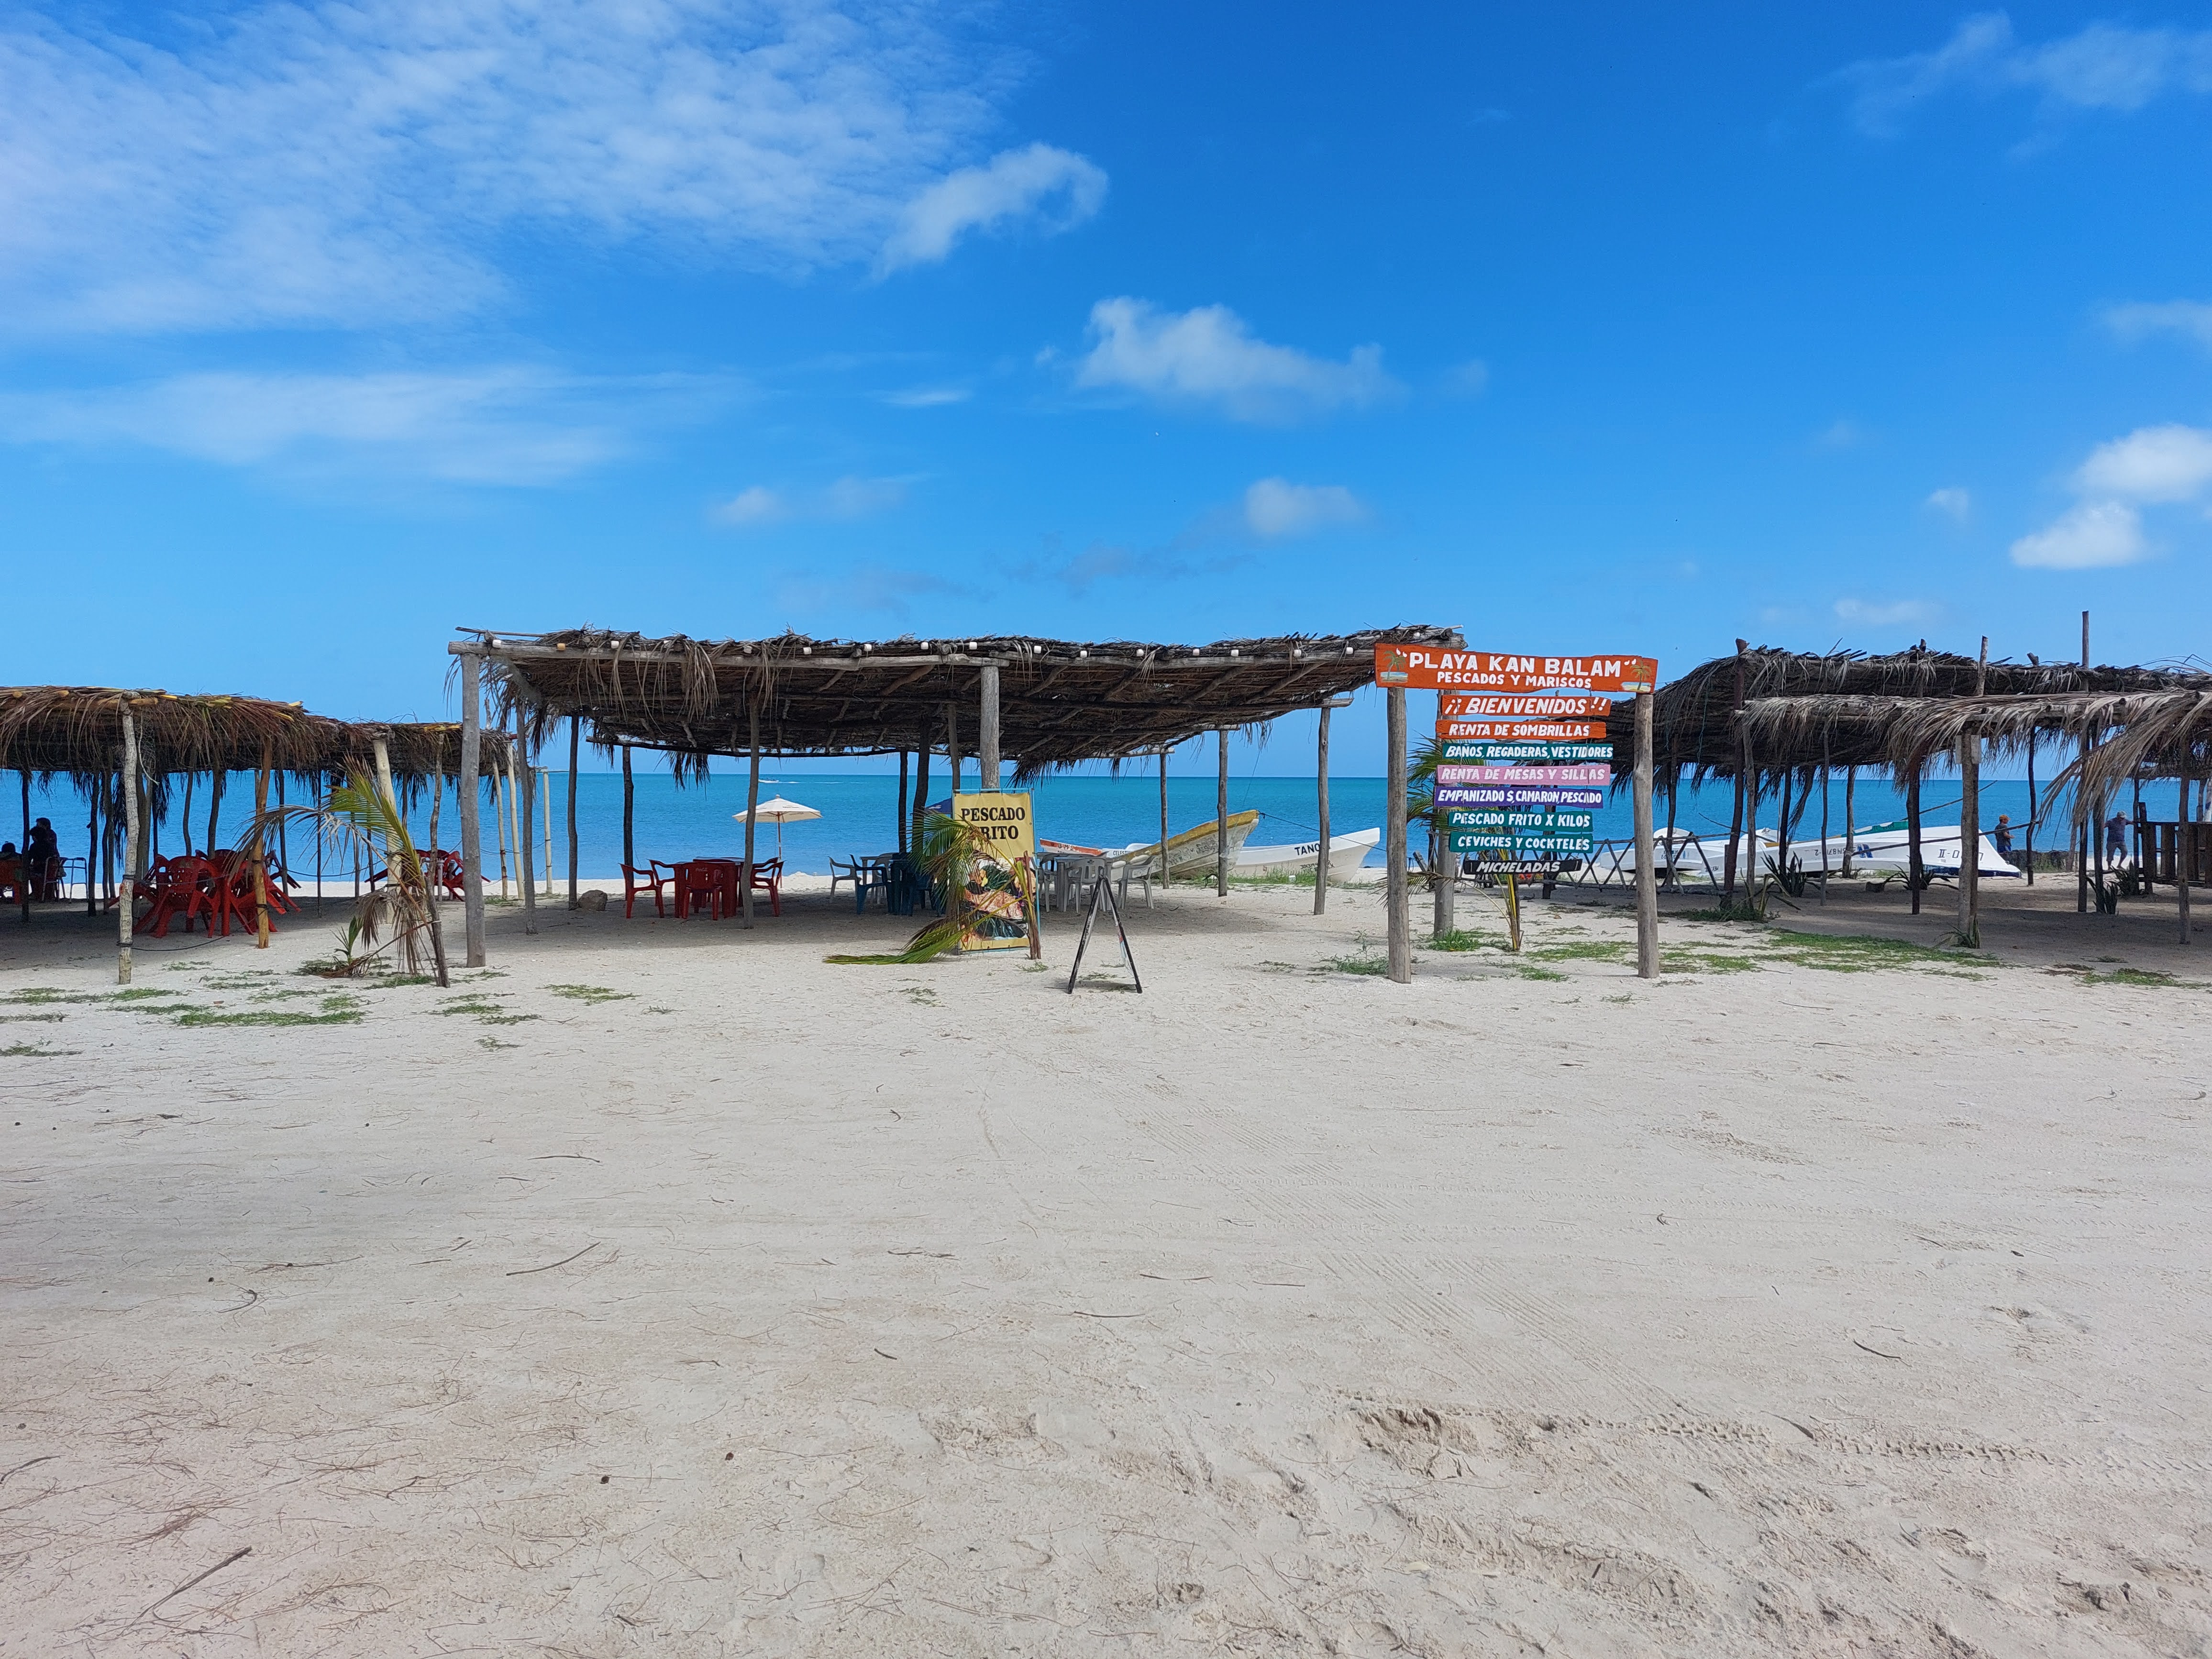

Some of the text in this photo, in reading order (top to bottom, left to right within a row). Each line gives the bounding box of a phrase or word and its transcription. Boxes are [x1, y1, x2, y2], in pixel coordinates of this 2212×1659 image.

[1489, 655, 1535, 673] KAN
[1437, 671, 1592, 688] PESCADOS Y MARISCOS
[1465, 697, 1587, 714] BIENVENIDOS
[1449, 724, 1591, 737] RENTA DE SOMBRILLAS
[1445, 743, 1614, 759] BAÑOS, REGADERAS, VESTIDORES
[1441, 768, 1605, 780] RENTA DE MESAS Y SILLAS
[1560, 791, 1602, 804] PESCADO
[961, 807, 1026, 821] PESCADO
[1452, 812, 1591, 828] PESCADO FRITO X KILOS
[1458, 835, 1590, 851] CEVICHES Y COCKTELES
[1476, 862, 1561, 873] MICHELADAS
